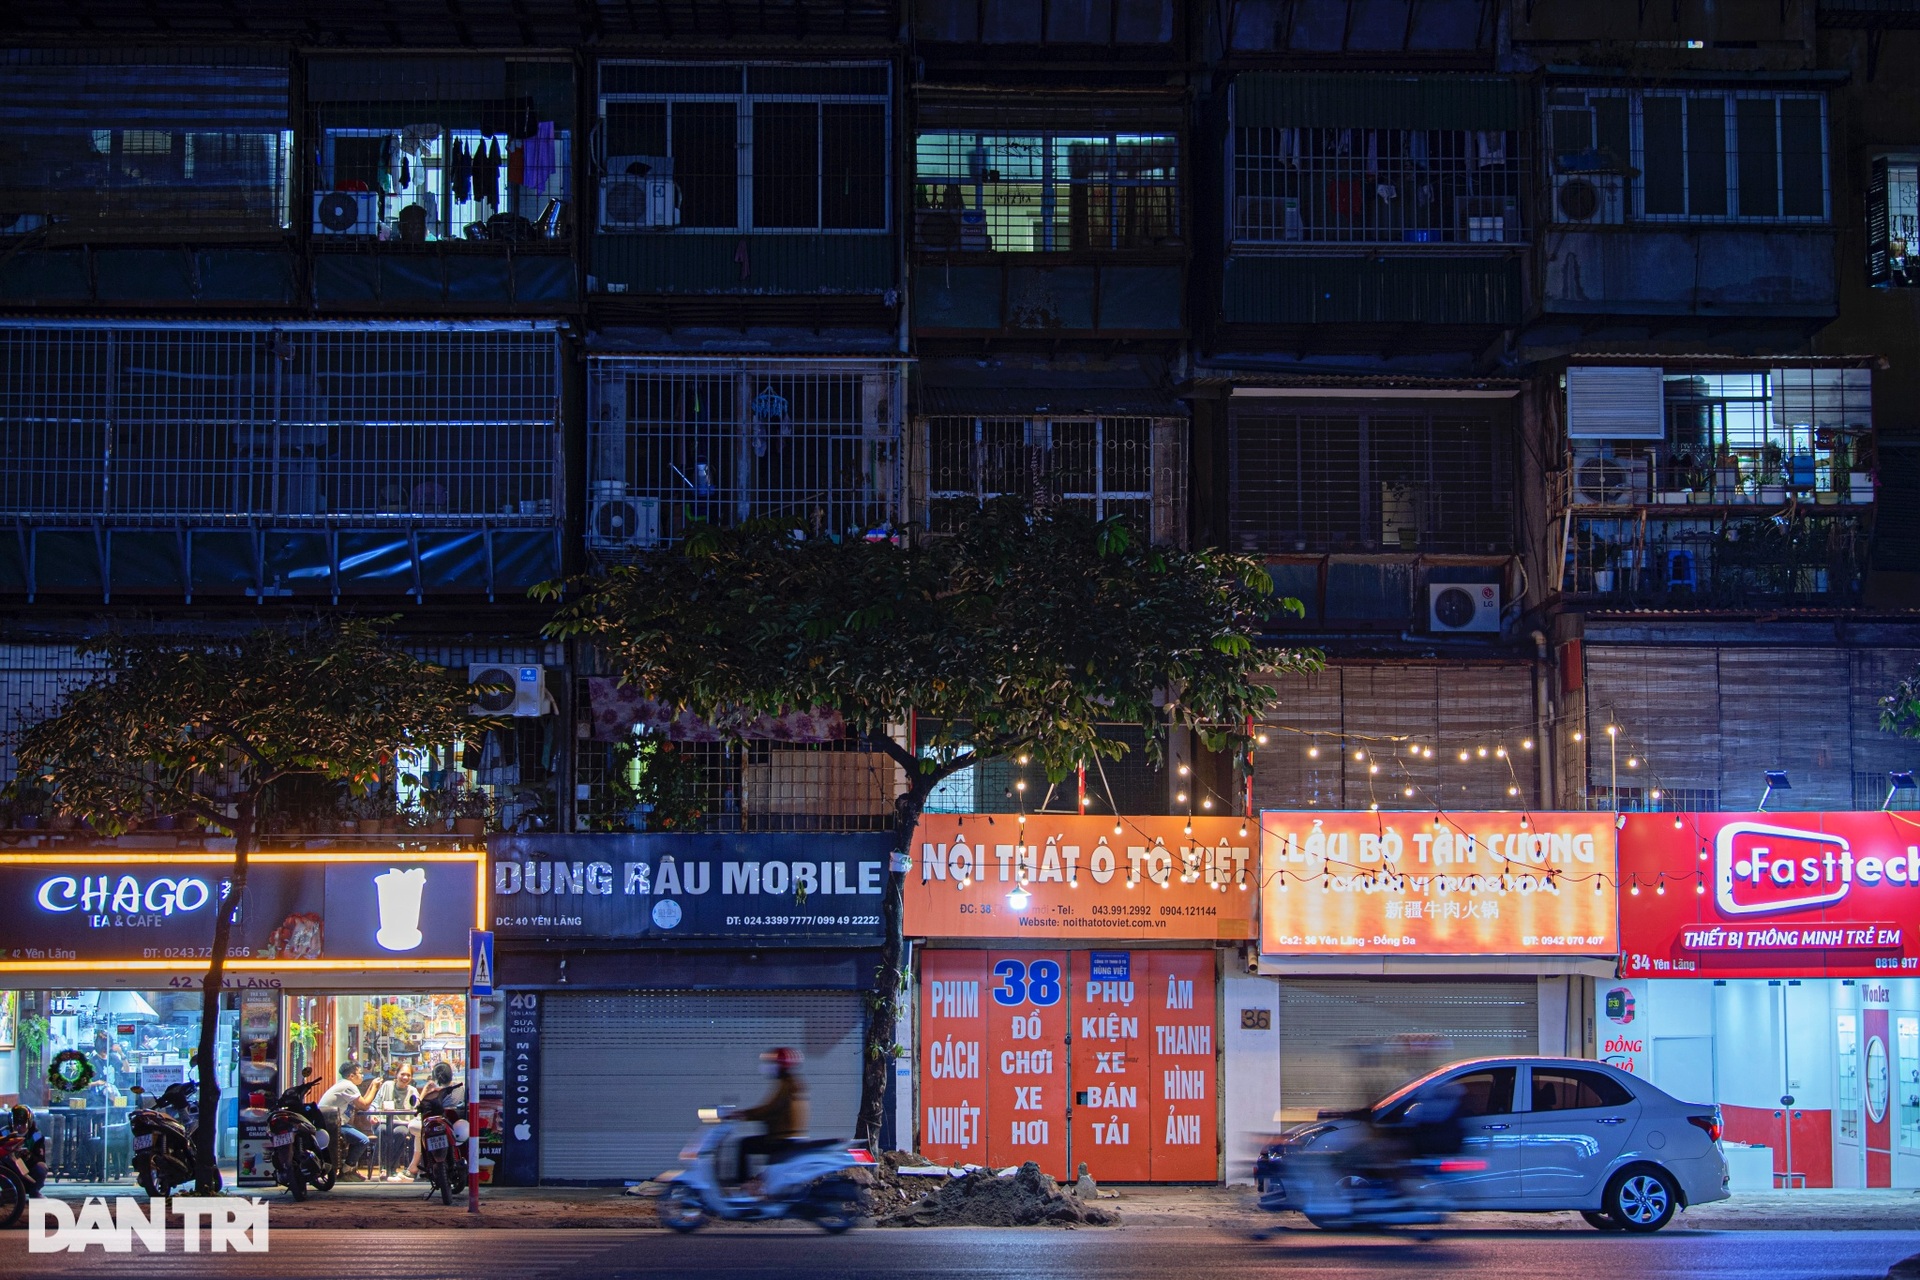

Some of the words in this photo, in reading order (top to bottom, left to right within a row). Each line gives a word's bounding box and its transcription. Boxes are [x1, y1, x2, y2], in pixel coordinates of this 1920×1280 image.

[1288, 819, 1348, 866] LẨU
[1359, 826, 1403, 863] BÒ
[1413, 826, 1477, 866] TÂN
[1487, 832, 1594, 864] CƯƠNG
[922, 834, 984, 892] NỘI
[995, 833, 1080, 883] THẤT
[1090, 836, 1116, 884] Ô
[1127, 836, 1173, 884] TÔ
[1179, 837, 1249, 892] VIỆT
[722, 861, 882, 895] MOBILE
[37, 875, 209, 916] CHAGO
[88, 915, 110, 928] TEA
[115, 915, 124, 927] &
[496, 917, 514, 926] ĐC:
[515, 917, 528, 926] 40
[531, 915, 551, 926] YÊN
[554, 915, 582, 926] LÃNG
[726, 916, 741, 925] ĐT:
[837, 916, 849, 925] 49
[851, 916, 880, 925] 22222
[960, 904, 977, 914] ĐC:
[980, 904, 992, 914] 38
[1058, 905, 1074, 914] Tel:
[1092, 905, 1151, 916] 043.991.2992
[1160, 906, 1217, 916] 0904.121144
[1385, 901, 1500, 919] 新疆牛肉火锅
[1019, 917, 1060, 927] Website:
[1062, 917, 1167, 928] noithatotoviet.com.vn
[1280, 936, 1302, 945] Cs2:
[1319, 935, 1338, 945] Yên
[1340, 935, 1365, 947] Lãng
[1373, 934, 1400, 947] Đống
[1402, 936, 1416, 945] Đa
[1541, 936, 1564, 945] 0942
[1567, 936, 1584, 945] 070
[1586, 936, 1605, 945] 407
[1684, 927, 1727, 947] THIẾT
[1728, 931, 1743, 948] BỊ
[1746, 928, 1798, 947] THÔNG
[1802, 930, 1843, 945] MINH
[1846, 926, 1874, 945] TRẺ
[1878, 930, 1900, 945] EM
[12, 949, 21, 958] 42
[25, 948, 45, 959] Yên
[48, 947, 76, 960] Lãng
[143, 948, 161, 959] ĐT:
[1632, 953, 1650, 970] 34
[1653, 957, 1670, 970] Yên
[1672, 957, 1696, 972] Lãng
[1875, 957, 1898, 969] 0816
[1901, 957, 1918, 969] 917
[169, 976, 192, 988] 42
[237, 977, 282, 988] LÃNG
[992, 958, 1062, 1007] 38
[1093, 966, 1112, 975] HÙNG
[1113, 966, 1127, 977] VIỆT
[510, 994, 537, 1009] 40
[931, 981, 979, 1018] PHIM
[1086, 981, 1135, 1007] PHỤ
[1166, 974, 1193, 1009] ÂM
[1862, 984, 1890, 1003] Wonlex
[1011, 1010, 1042, 1040] ĐỒ
[1081, 1012, 1138, 1043] KIỆN
[1242, 1010, 1269, 1029] 36
[1155, 1026, 1211, 1055] THANH
[1605, 1035, 1642, 1053] ĐỒNG
[930, 1034, 979, 1079] CÁCH
[1000, 1049, 1053, 1075] CHƠI
[1095, 1051, 1126, 1074] XE
[516, 1042, 529, 1115] MACBOOK
[1164, 1065, 1205, 1100] HÌNH
[1014, 1086, 1043, 1110] XE
[1087, 1082, 1137, 1108] BÁN
[927, 1100, 980, 1150] NHIỆT
[1011, 1119, 1049, 1145] HƠI
[1092, 1115, 1129, 1145] TẢI
[1165, 1105, 1201, 1145] ẢNH
